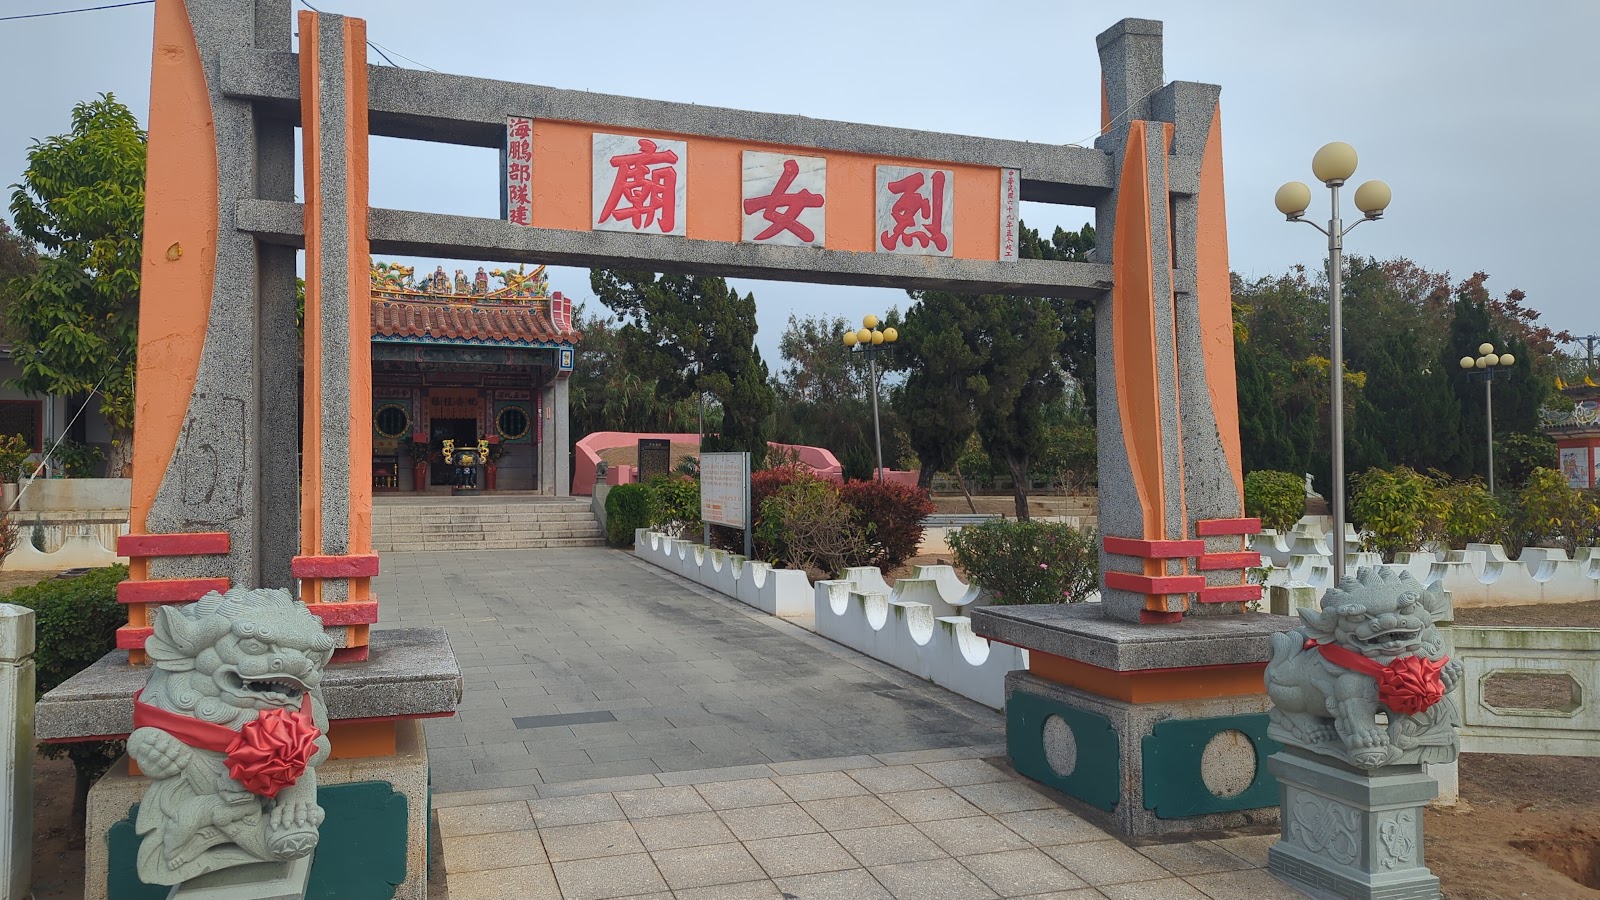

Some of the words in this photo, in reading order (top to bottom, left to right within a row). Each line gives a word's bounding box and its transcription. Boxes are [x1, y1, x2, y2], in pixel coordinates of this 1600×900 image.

[508, 117, 532, 227] 海鵬部隊建
